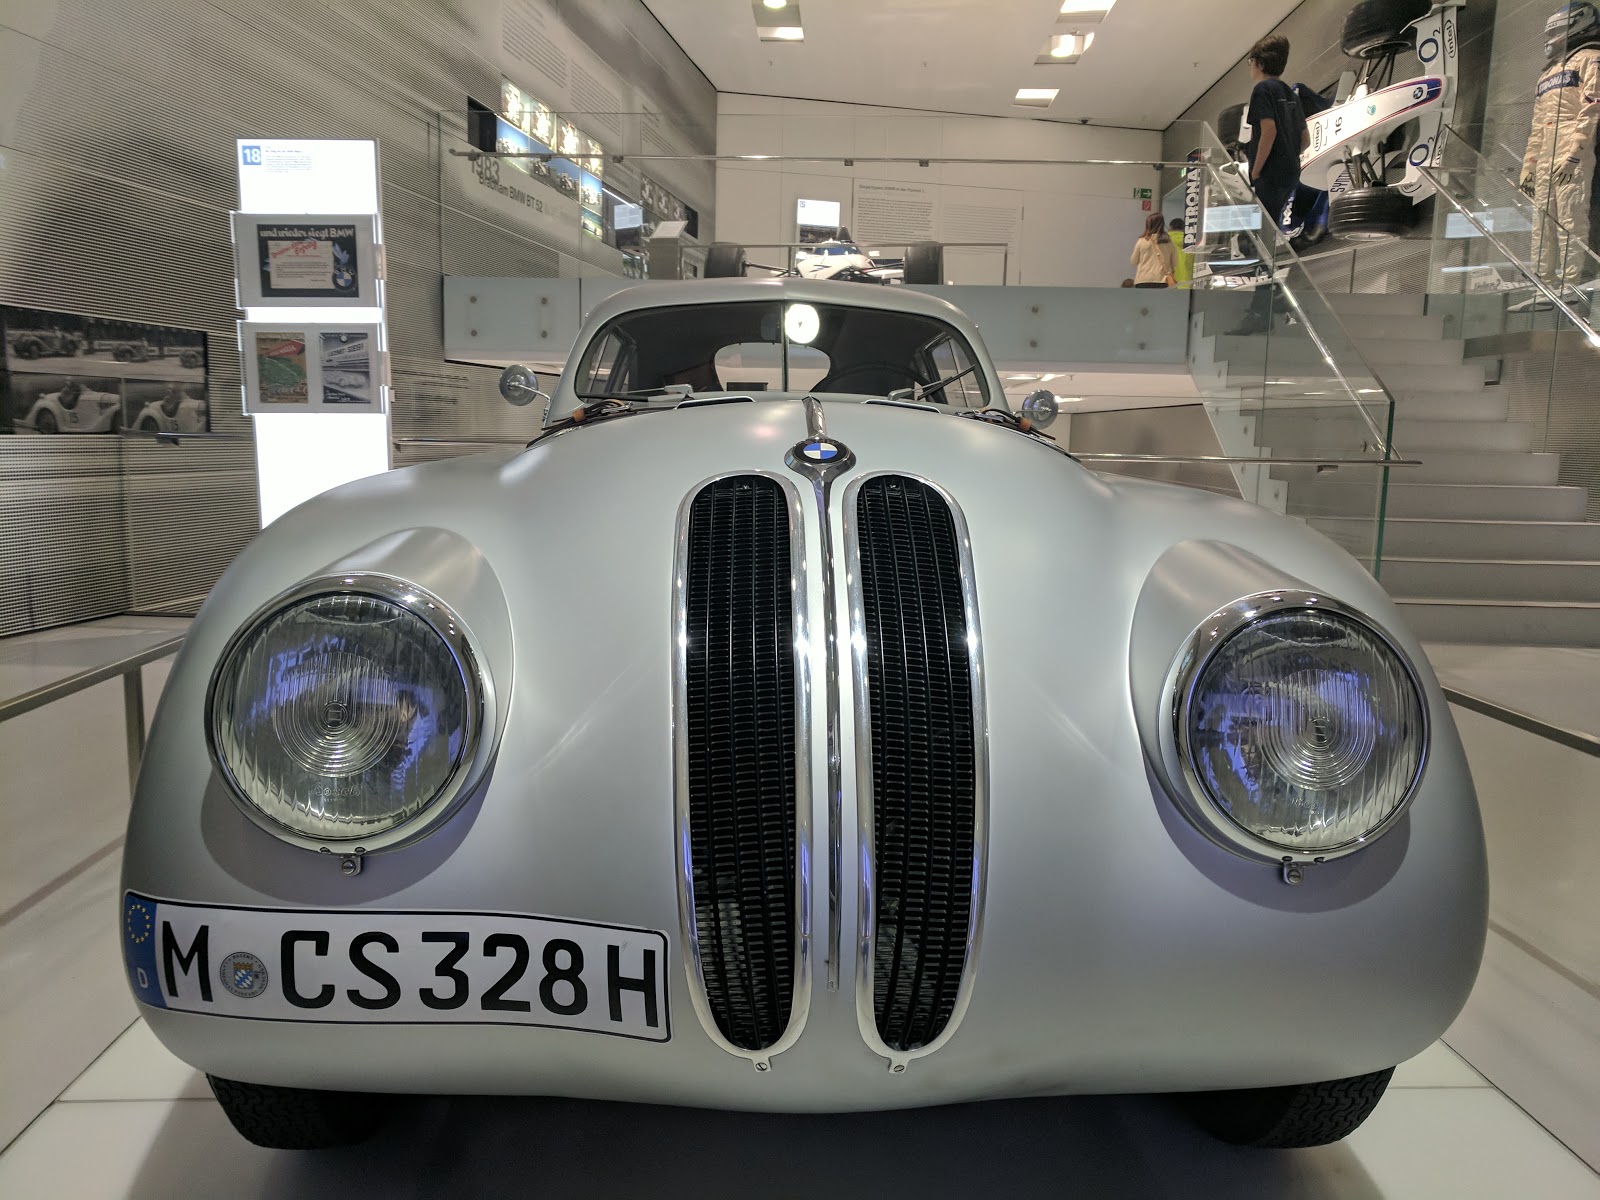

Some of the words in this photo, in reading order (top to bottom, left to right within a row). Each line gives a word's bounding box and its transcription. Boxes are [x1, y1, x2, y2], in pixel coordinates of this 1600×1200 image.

[1445, 23, 1456, 56] intel
[1312, 124, 1321, 149] intel
[1334, 116, 1343, 136] 16
[243, 148, 261, 163] 18
[470, 155, 500, 184] 1983
[509, 186, 526, 205] BMW
[526, 194, 536, 209] BT
[535, 198, 543, 213] 52
[260, 227, 277, 237] und
[329, 227, 354, 237] BMW
[162, 920, 214, 1003] M
[137, 967, 149, 989] D
